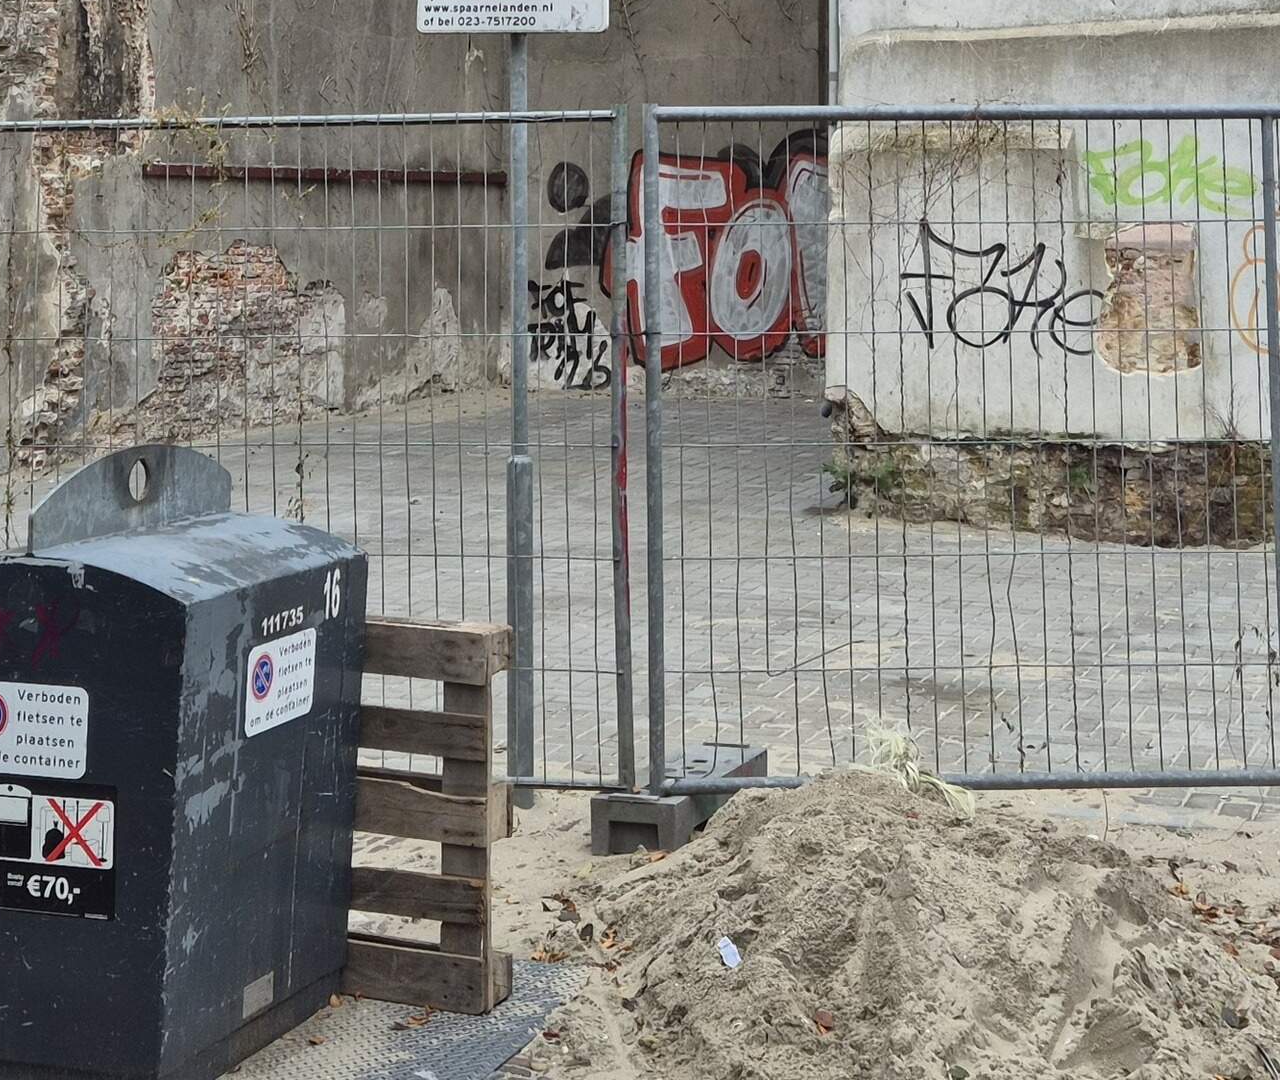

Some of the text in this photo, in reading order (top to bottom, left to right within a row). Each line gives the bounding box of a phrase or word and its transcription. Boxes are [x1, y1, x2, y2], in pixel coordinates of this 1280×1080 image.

[424, 16, 536, 26] of bel 023-7517200
[323, 568, 341, 620] 16
[261, 605, 304, 637] 111735
[279, 639, 311, 657] Verboden
[305, 657, 312, 667] te
[17, 688, 81, 705] Verboden
[17, 710, 83, 726] fietsen te
[249, 695, 309, 727] om de container
[16, 733, 74, 748] plaatsen
[14, 754, 81, 769] container
[26, 874, 81, 905] €70,-
